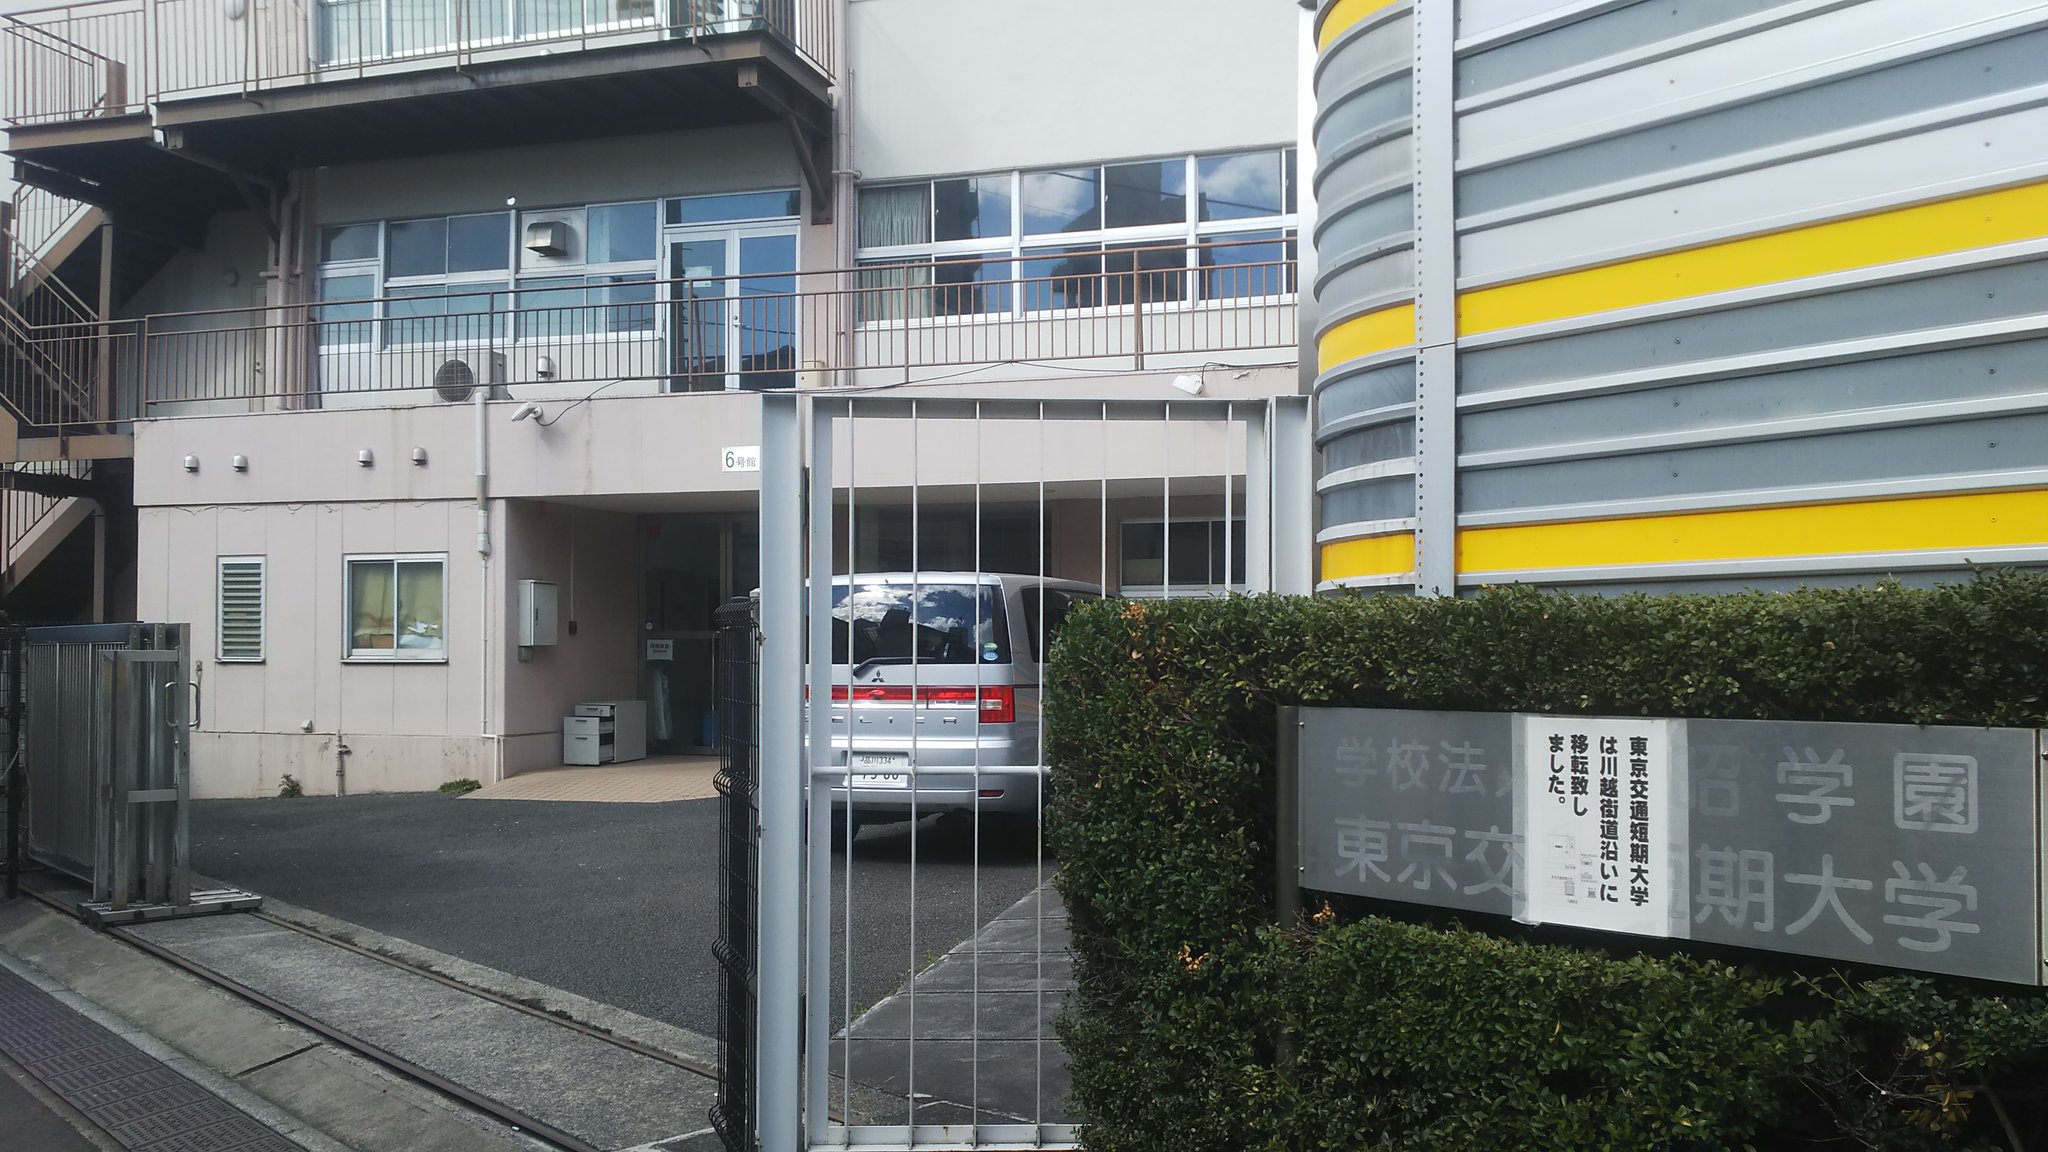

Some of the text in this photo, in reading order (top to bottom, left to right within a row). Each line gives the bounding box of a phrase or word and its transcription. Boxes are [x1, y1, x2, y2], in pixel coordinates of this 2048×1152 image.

[725, 450, 757, 469] 6号館
[1548, 734, 1566, 804] ました。
[1570, 734, 1589, 817] 移転致し
[1599, 736, 1619, 904] は川越街道沿いに
[1629, 736, 1650, 907] 東京交通短期大学
